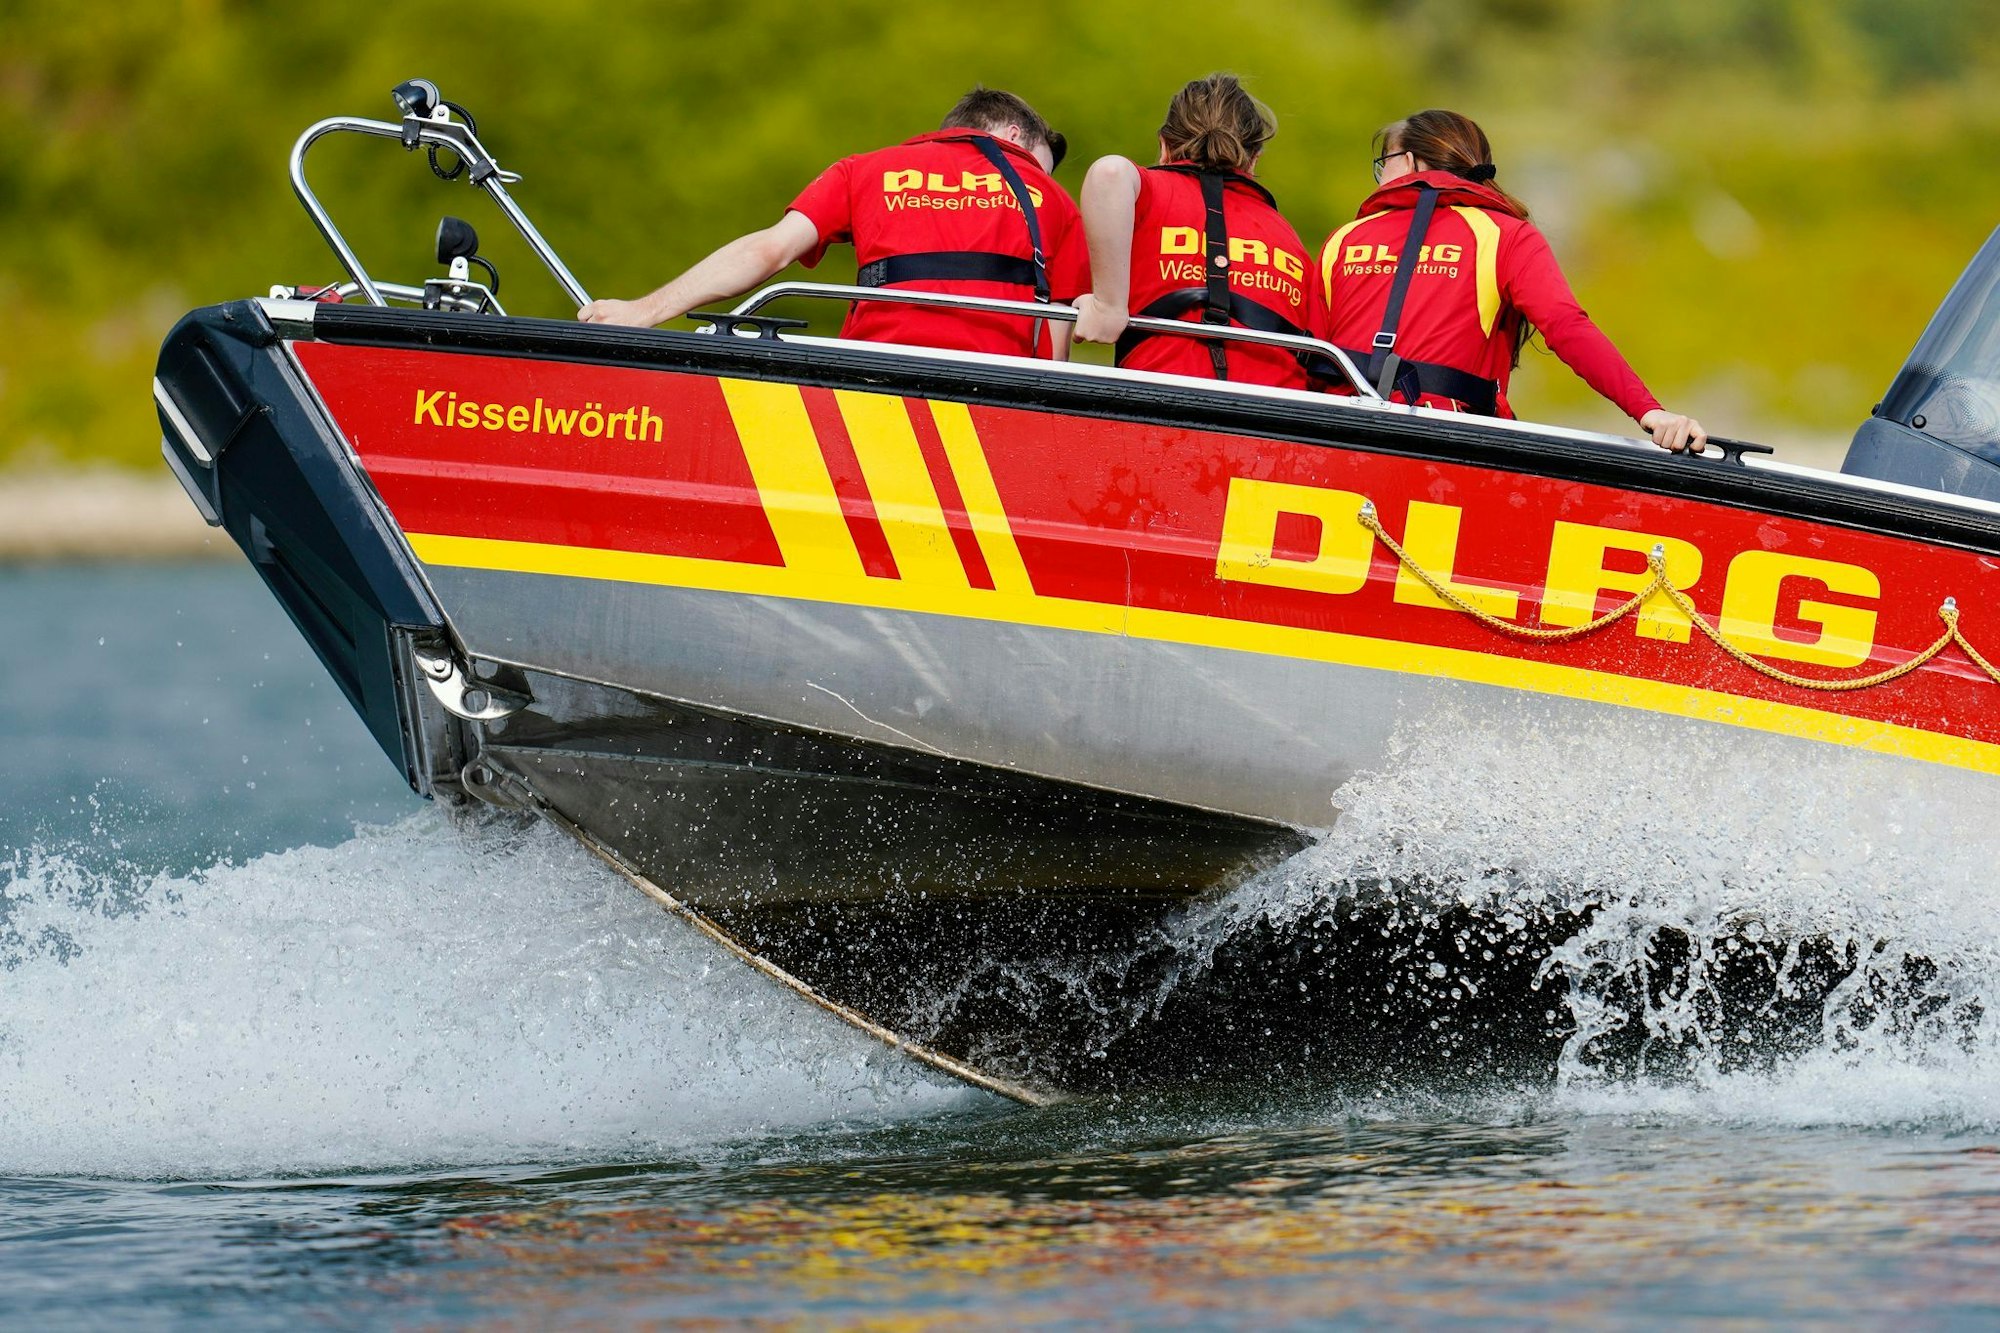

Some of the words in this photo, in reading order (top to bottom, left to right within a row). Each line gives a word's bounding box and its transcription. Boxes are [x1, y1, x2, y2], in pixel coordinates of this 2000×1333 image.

[884, 192, 1027, 224] Wasserrettu
[1160, 226, 1304, 283] DRG
[1343, 264, 1459, 279] Wasserttung
[1159, 260, 1302, 306] Wasrettung
[414, 389, 663, 442] Kisselwörth
[1215, 477, 1881, 668] DLRG
